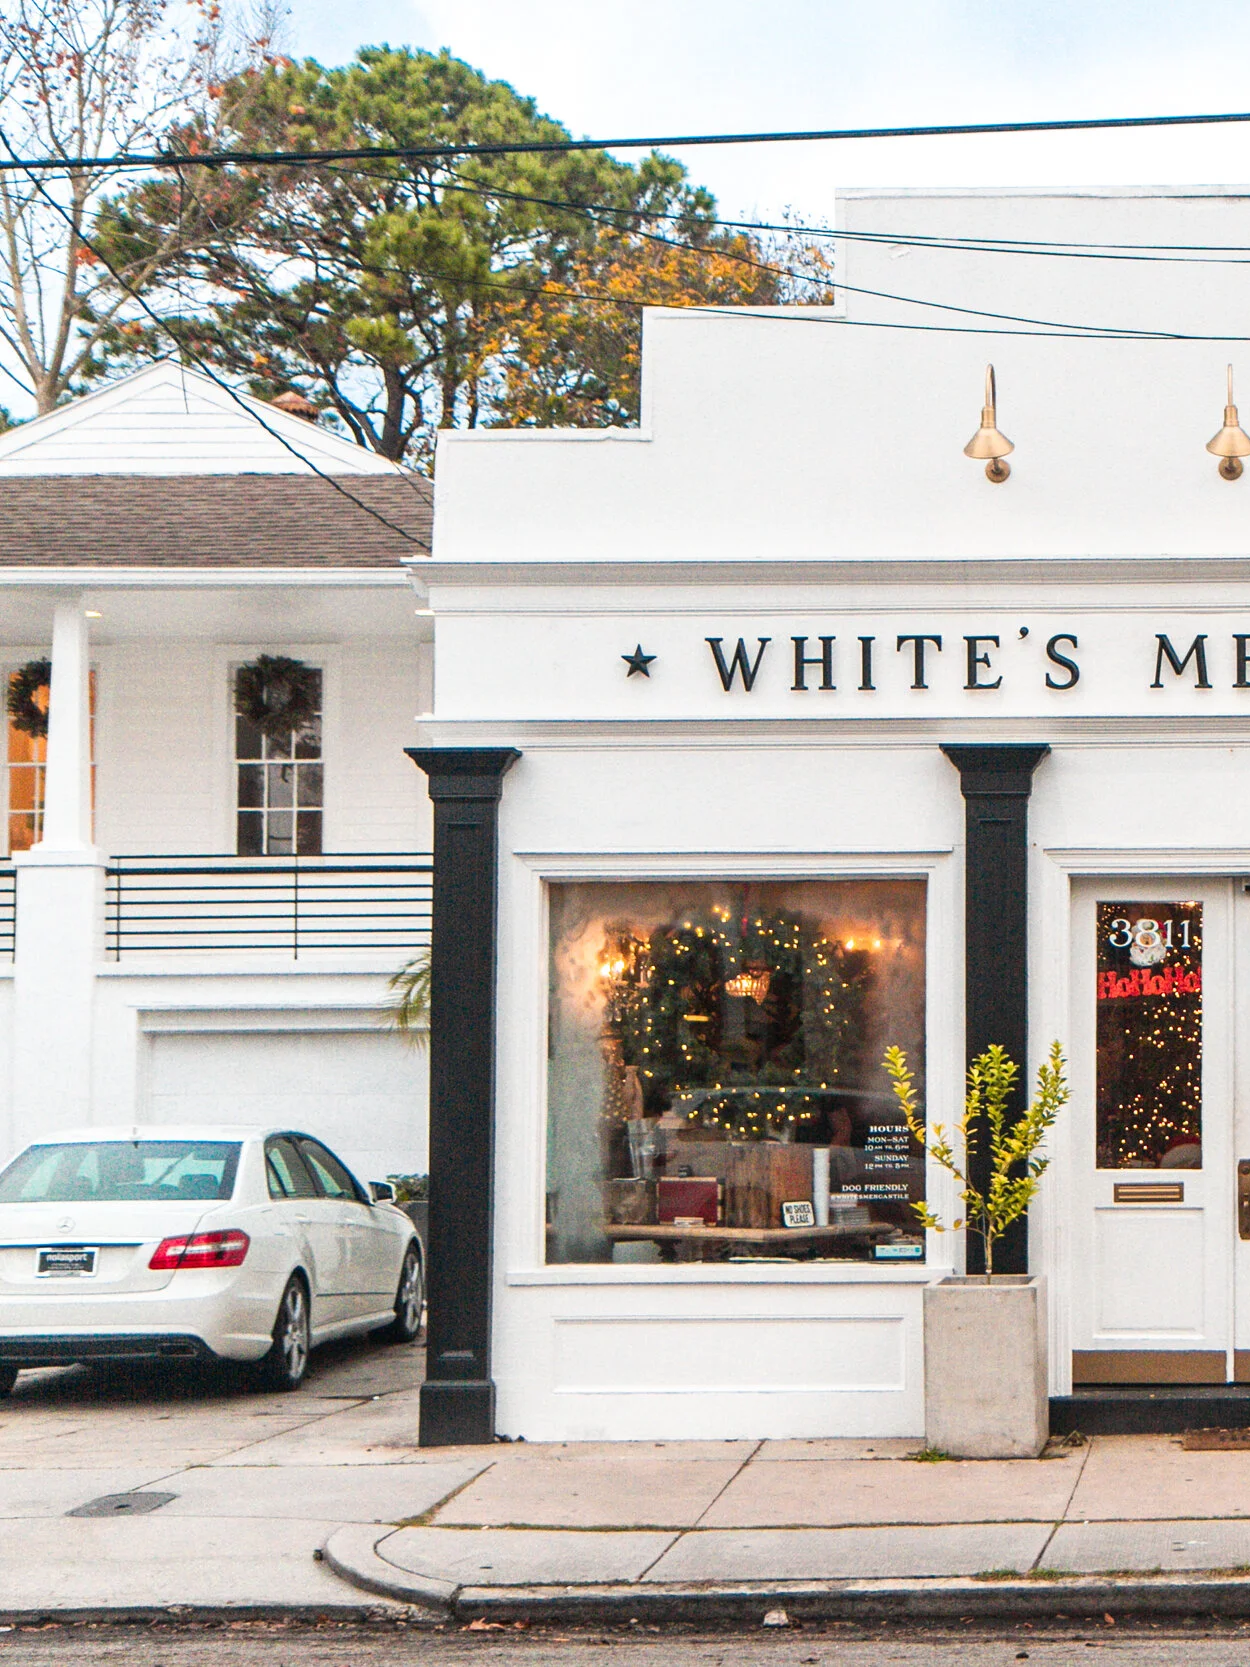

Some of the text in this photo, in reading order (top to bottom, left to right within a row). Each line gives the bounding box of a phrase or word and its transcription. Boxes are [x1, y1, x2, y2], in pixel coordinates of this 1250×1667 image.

[705, 627, 1080, 692] WHITE'S
[1109, 918, 1191, 948] 3811
[869, 1125, 909, 1133] HOURS
[841, 1184, 861, 1192] DOG
[785, 1205, 793, 1214] NO
[789, 1214, 809, 1225] PLEASE
